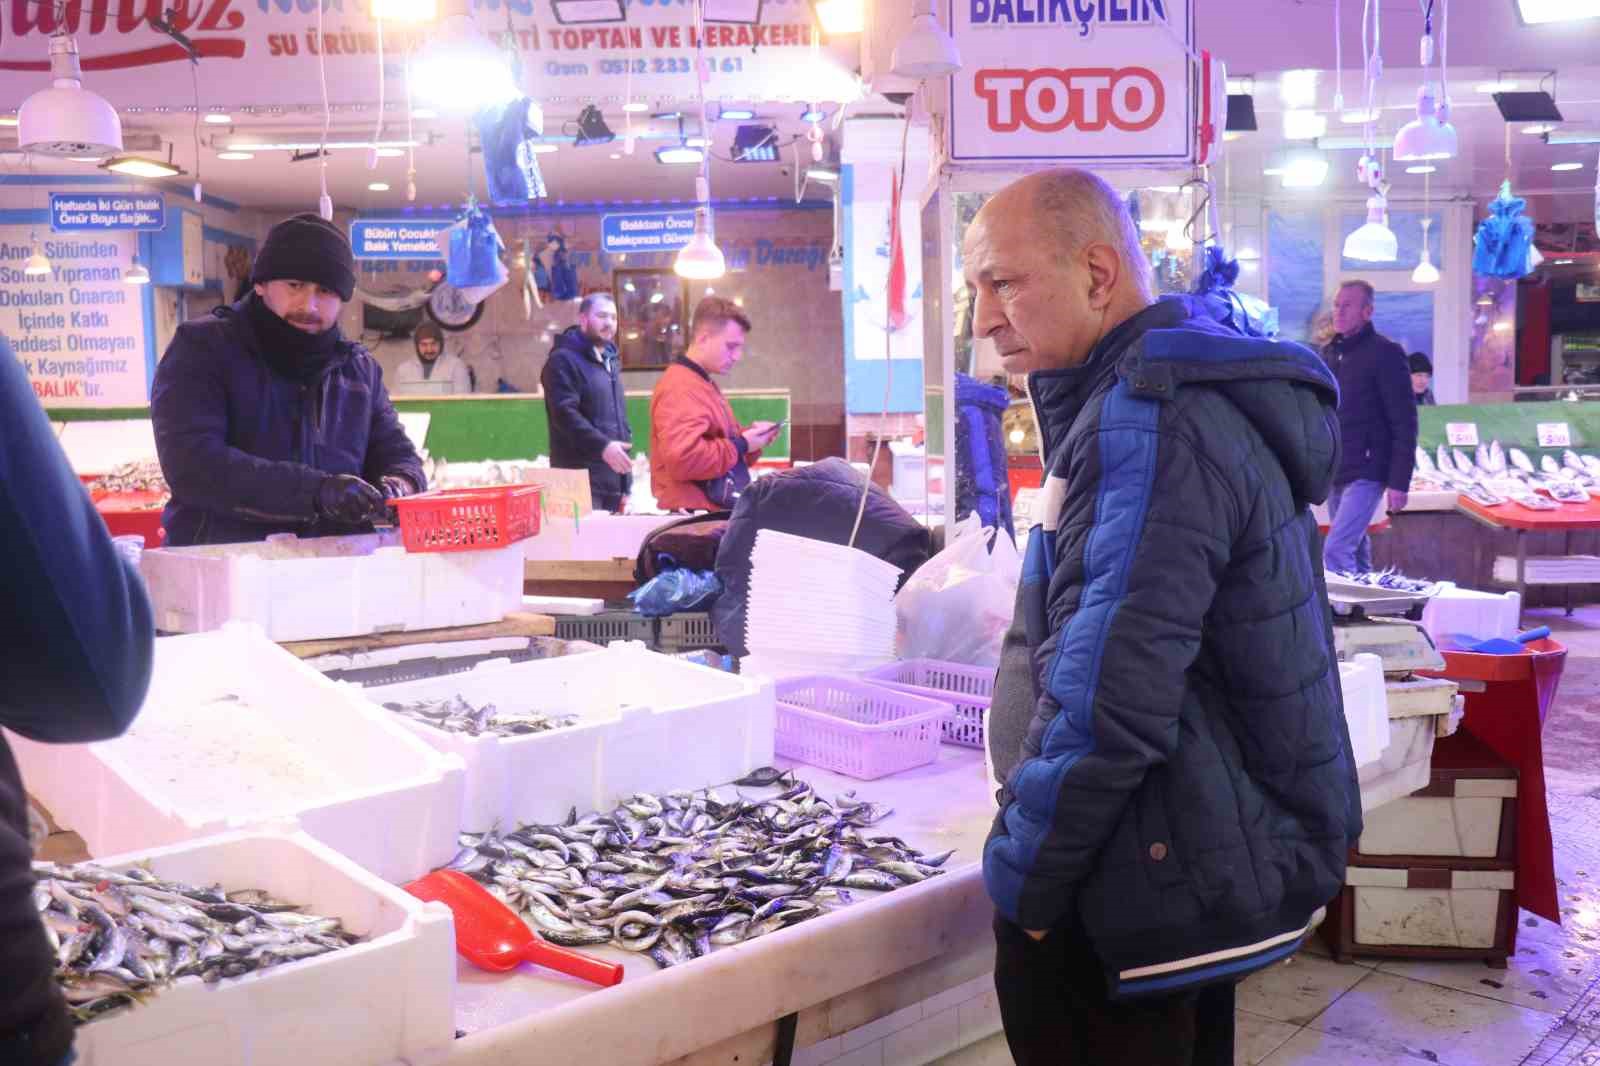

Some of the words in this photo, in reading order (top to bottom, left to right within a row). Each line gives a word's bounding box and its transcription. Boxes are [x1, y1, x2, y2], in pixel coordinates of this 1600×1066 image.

[267, 33, 299, 57] SU
[549, 26, 643, 50] TOPTAN
[651, 26, 681, 49] VE
[976, 67, 1165, 132] TOTO
[44, 240, 118, 259] Sütünden
[53, 266, 120, 290] Yıpranan
[18, 311, 65, 333] İçinde
[9, 335, 62, 352] addesi
[67, 335, 136, 355] Olmayan
